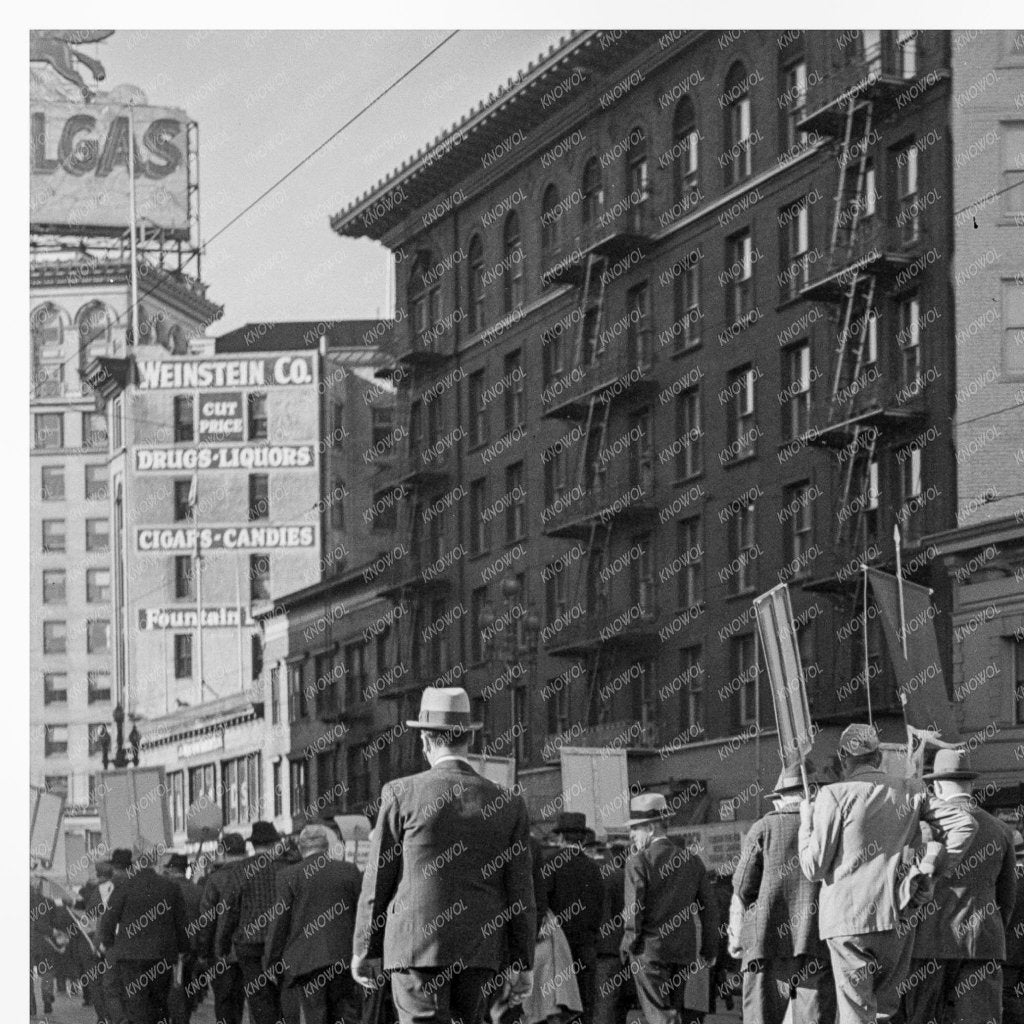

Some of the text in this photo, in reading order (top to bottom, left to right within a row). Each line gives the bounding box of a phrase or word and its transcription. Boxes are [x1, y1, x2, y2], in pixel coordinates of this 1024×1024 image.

[137, 355, 312, 390] WEINSTEIN CO.
[202, 400, 238, 417] CUT
[199, 418, 243, 434] PRICE
[145, 607, 241, 631] Fountain
